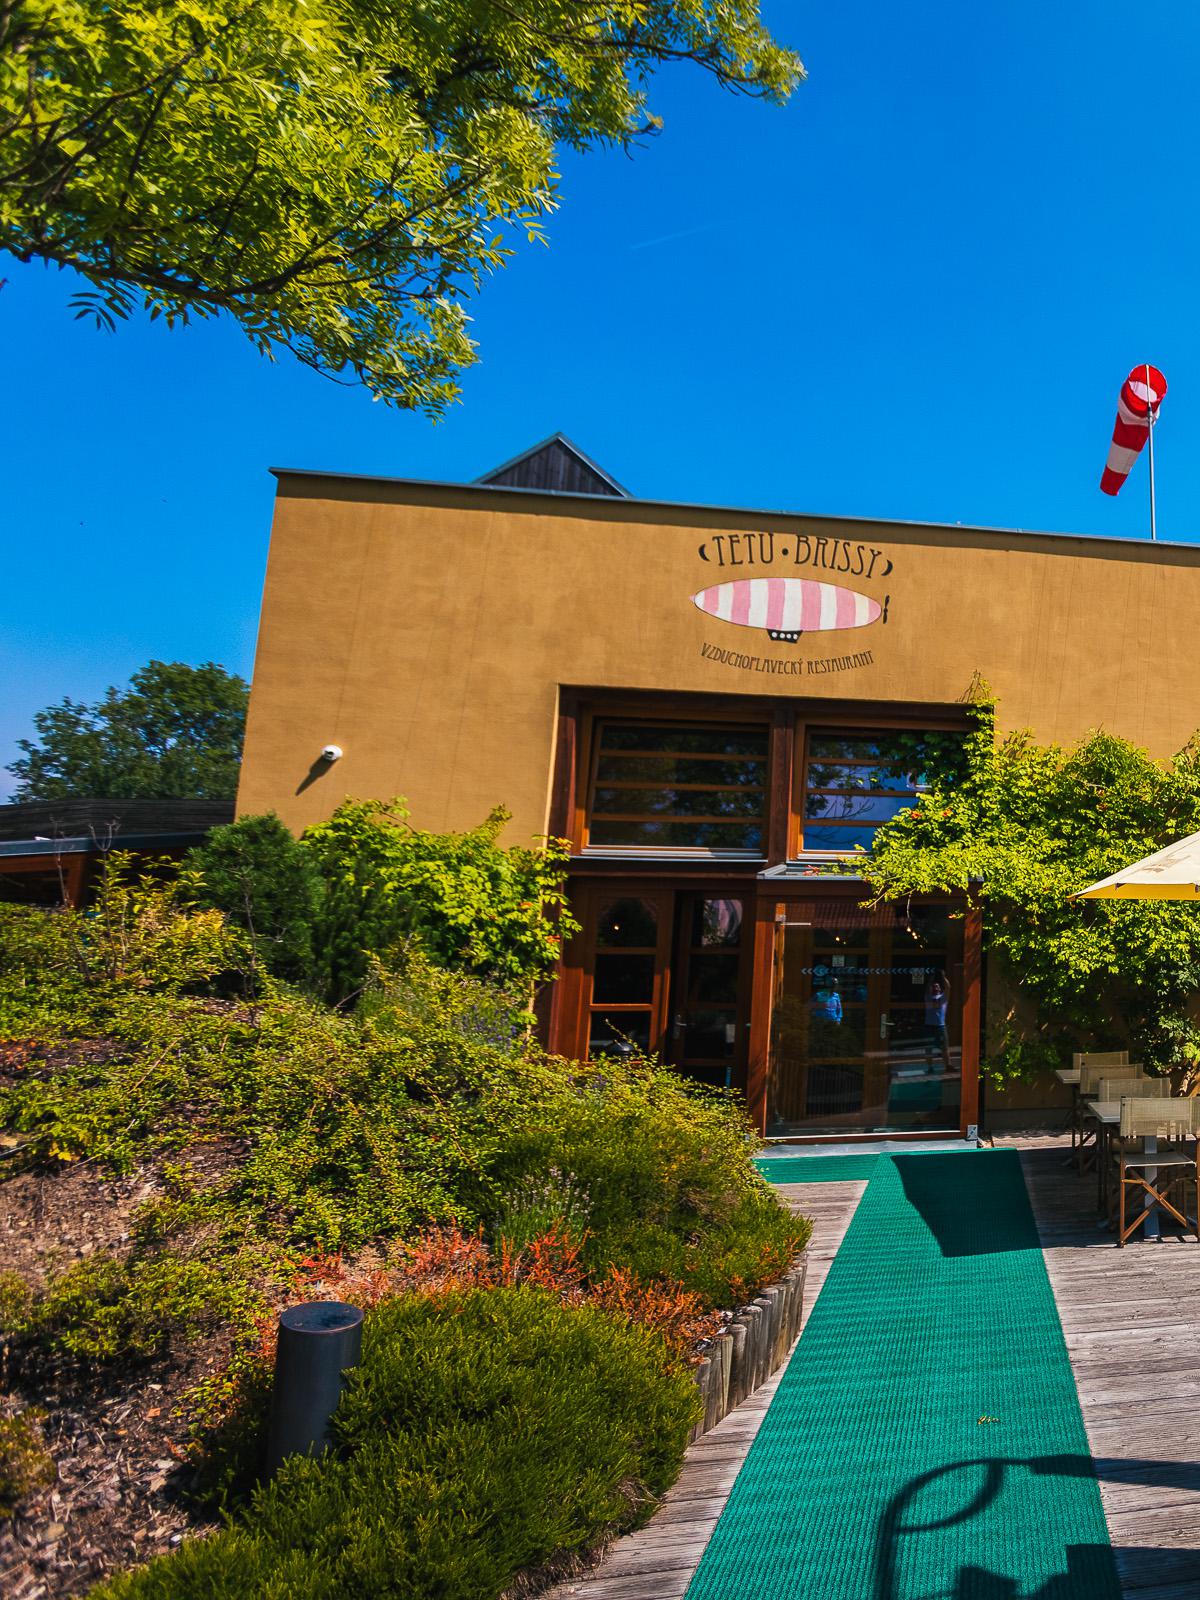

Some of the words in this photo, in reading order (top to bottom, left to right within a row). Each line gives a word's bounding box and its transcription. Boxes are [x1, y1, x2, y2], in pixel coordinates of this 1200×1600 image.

[712, 533, 775, 567] TETU
[793, 534, 883, 579] BRISSY
[700, 642, 804, 676] VZDUCHOPLAVECKÝ
[806, 649, 875, 676] RESTAURANT
